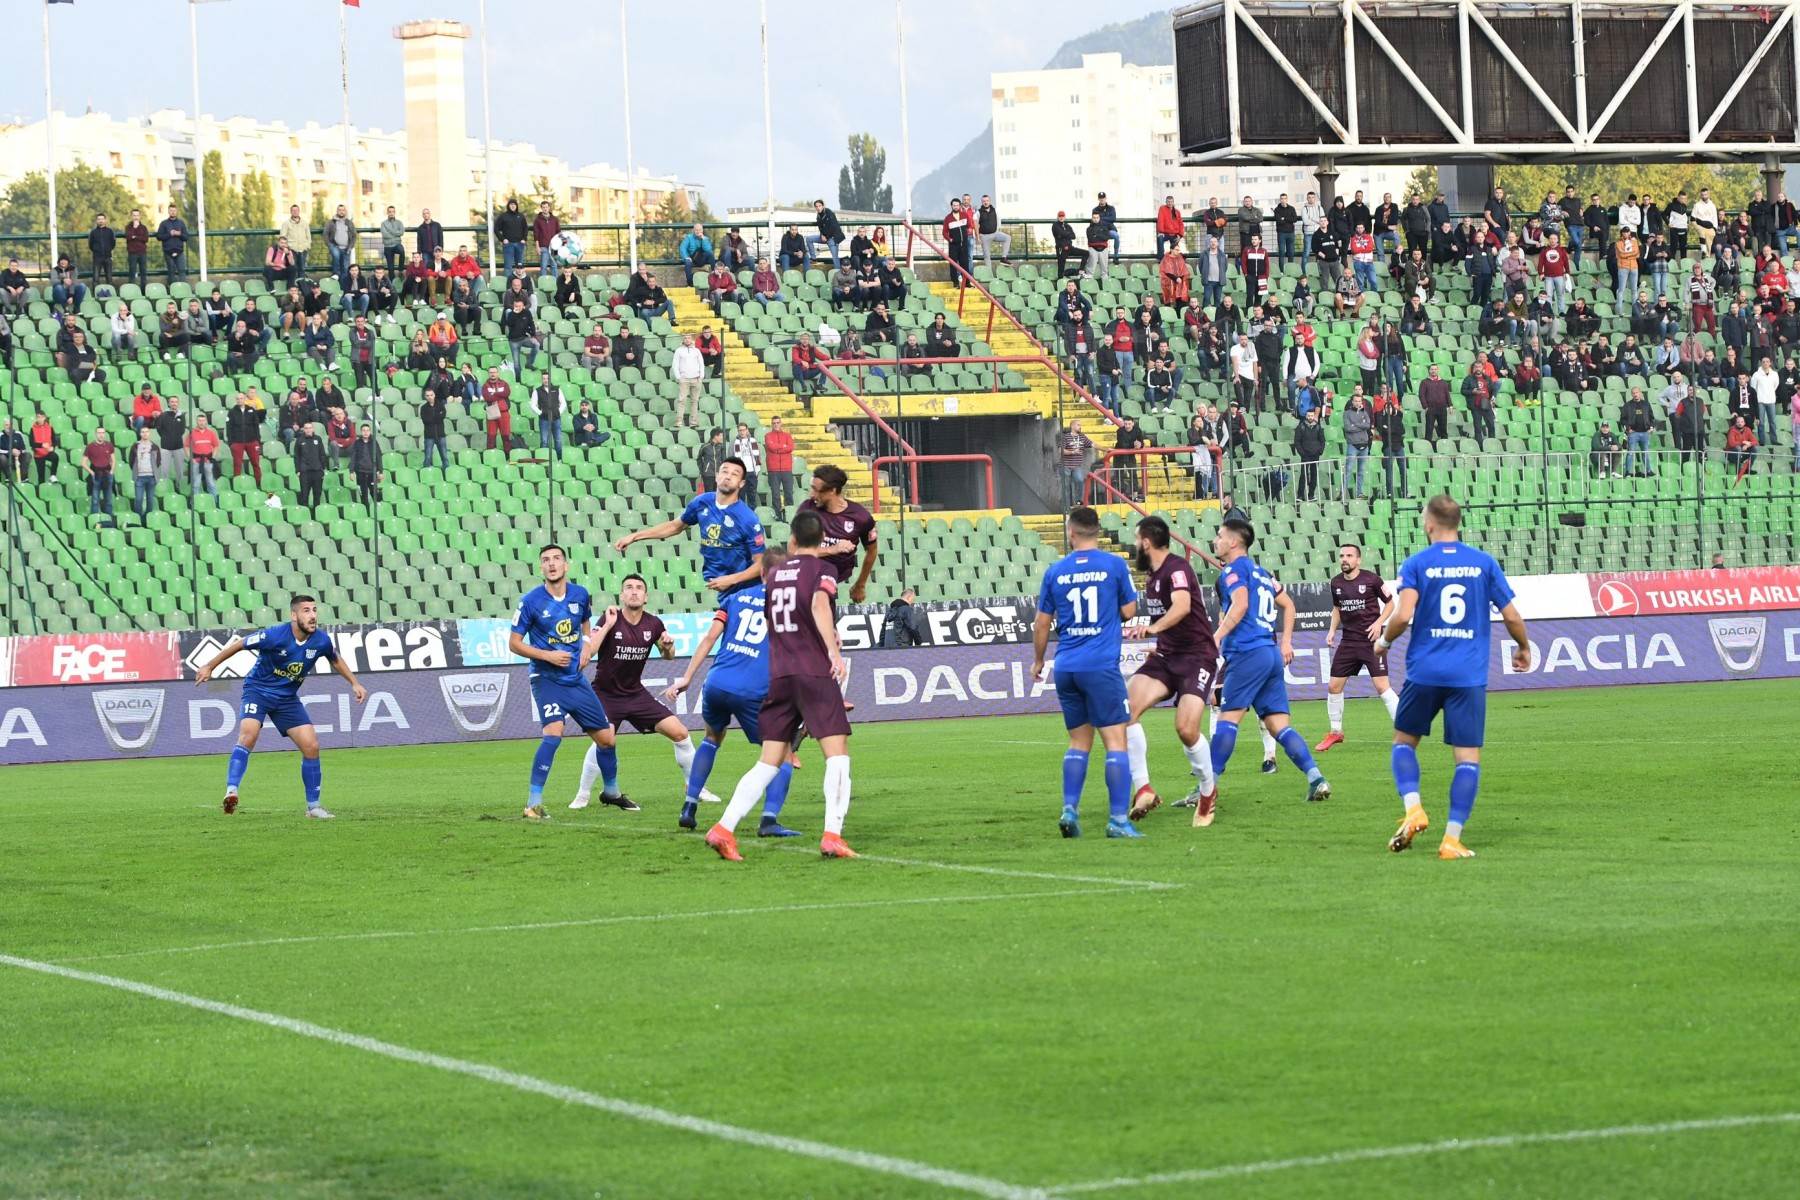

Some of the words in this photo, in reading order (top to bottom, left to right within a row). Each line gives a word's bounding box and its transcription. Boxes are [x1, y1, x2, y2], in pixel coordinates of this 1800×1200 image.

[771, 586, 799, 633] 22
[1066, 585, 1098, 624] 11
[1257, 585, 1278, 623] 10
[1440, 583, 1467, 624] 6
[1645, 588, 1744, 609] TURKISH
[734, 608, 768, 644] 19
[834, 606, 1018, 650] SECT
[973, 618, 1027, 638] player's
[1719, 626, 1757, 636] DACIA
[52, 643, 127, 682] FACE
[615, 645, 649, 654] TURKISH
[1500, 632, 1686, 675] DACIA
[105, 699, 153, 710] DACIA
[451, 683, 498, 694] DACIA
[188, 691, 411, 739] DCIA
[244, 703, 258, 714] 15
[543, 702, 562, 718] 22
